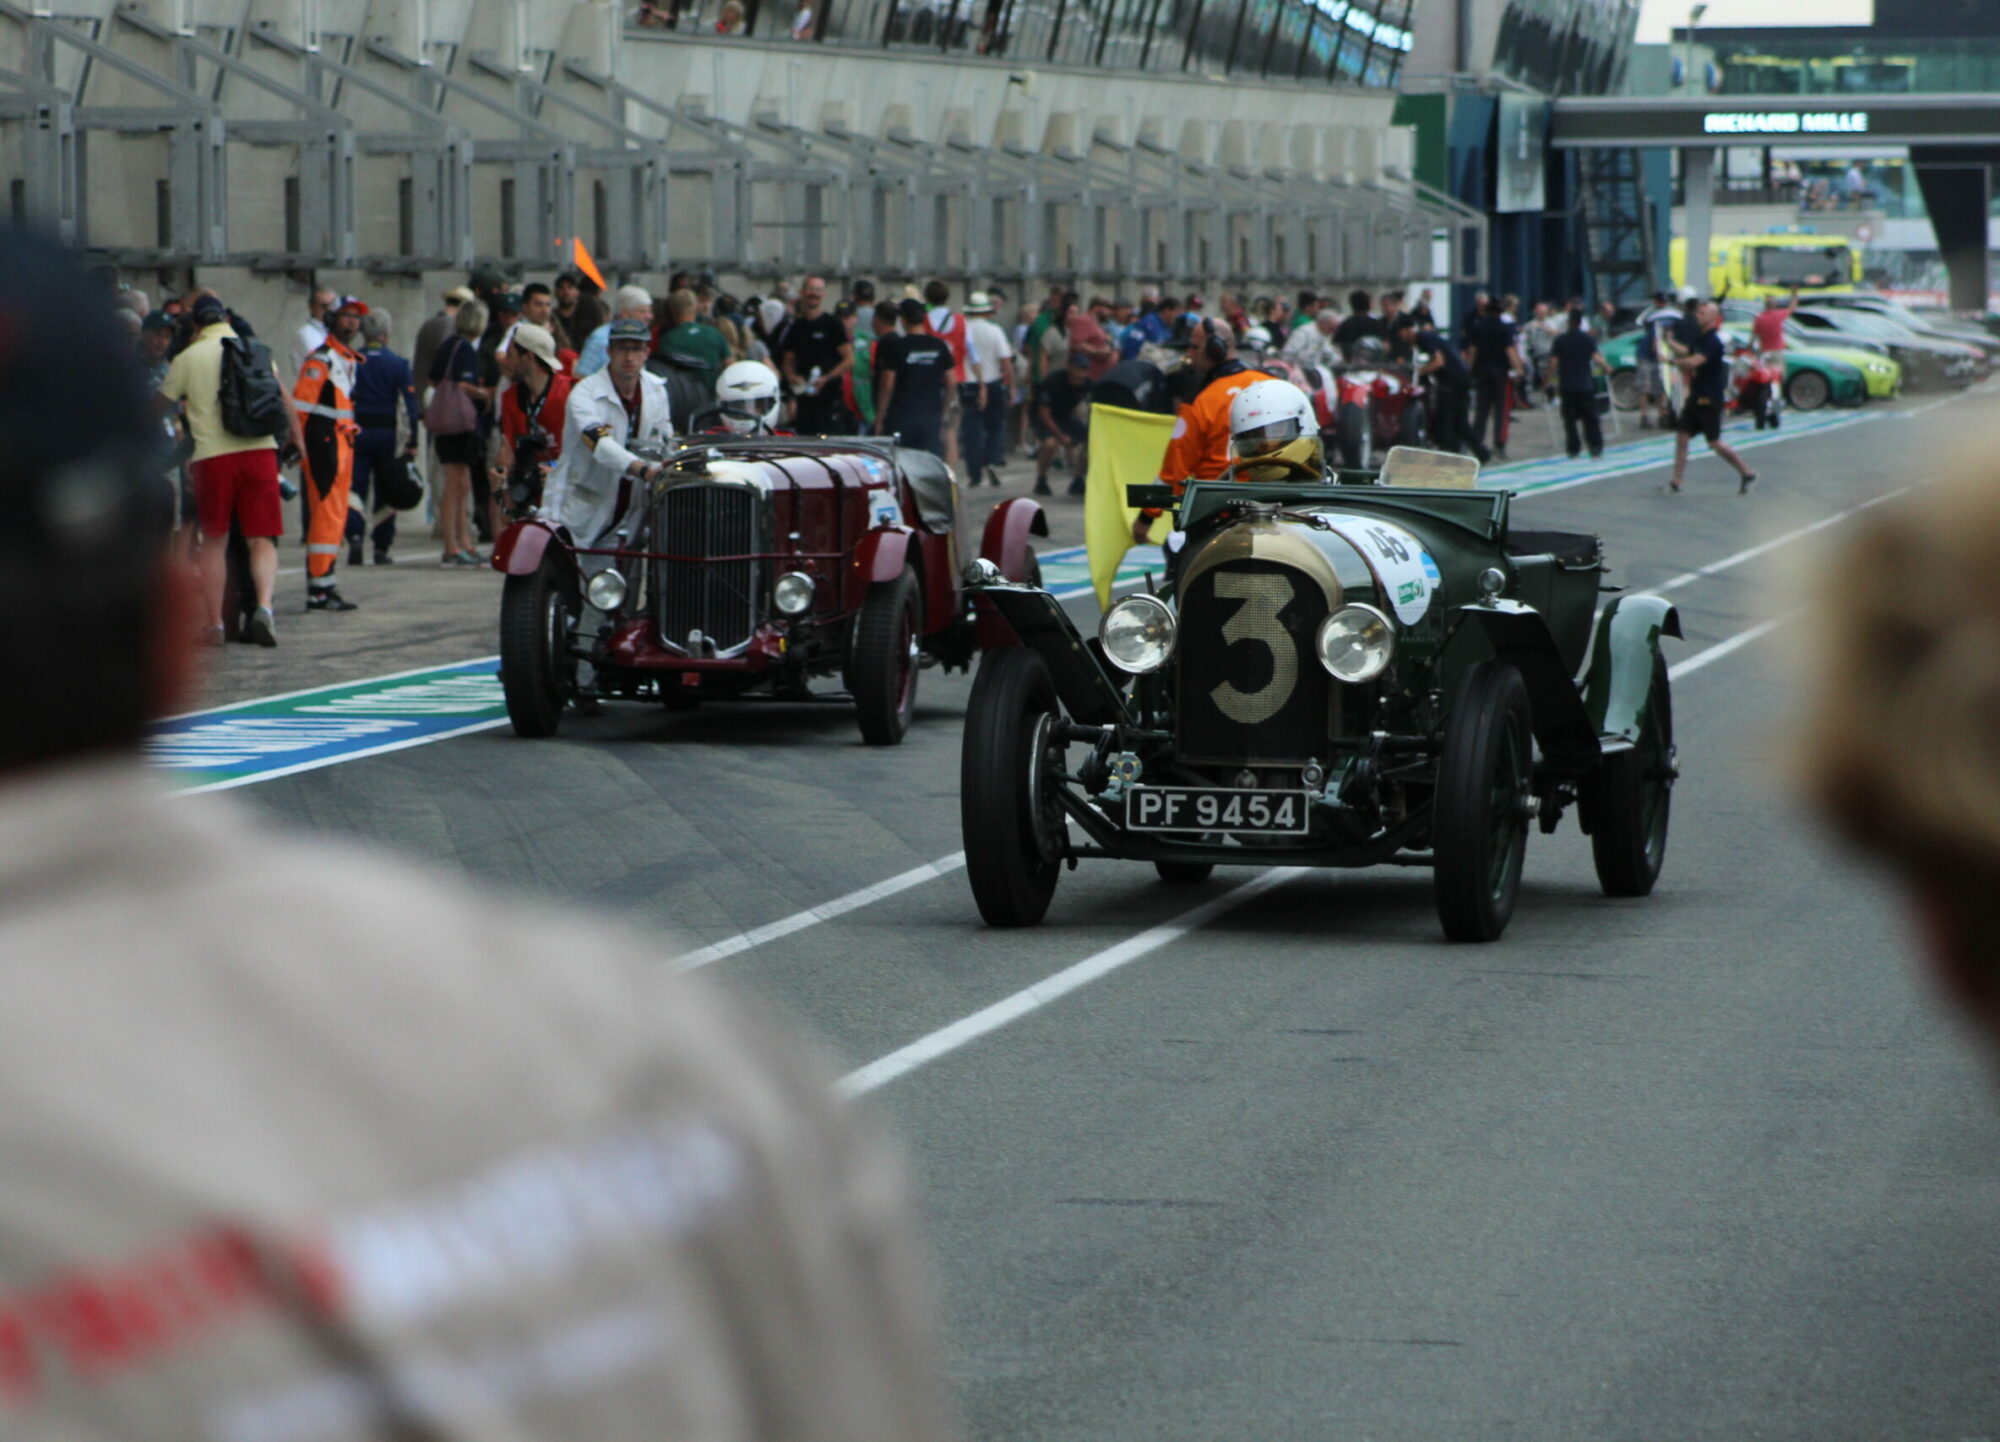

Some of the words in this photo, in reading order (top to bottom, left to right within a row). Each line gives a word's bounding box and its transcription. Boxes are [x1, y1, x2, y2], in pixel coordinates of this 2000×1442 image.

[1704, 113, 1799, 133] RICHARD
[1801, 112, 1868, 132] MILLE
[1364, 526, 1410, 565] 46
[1209, 571, 1299, 724] 3
[1140, 793, 1188, 825] PF
[1196, 794, 1296, 828] 9454
